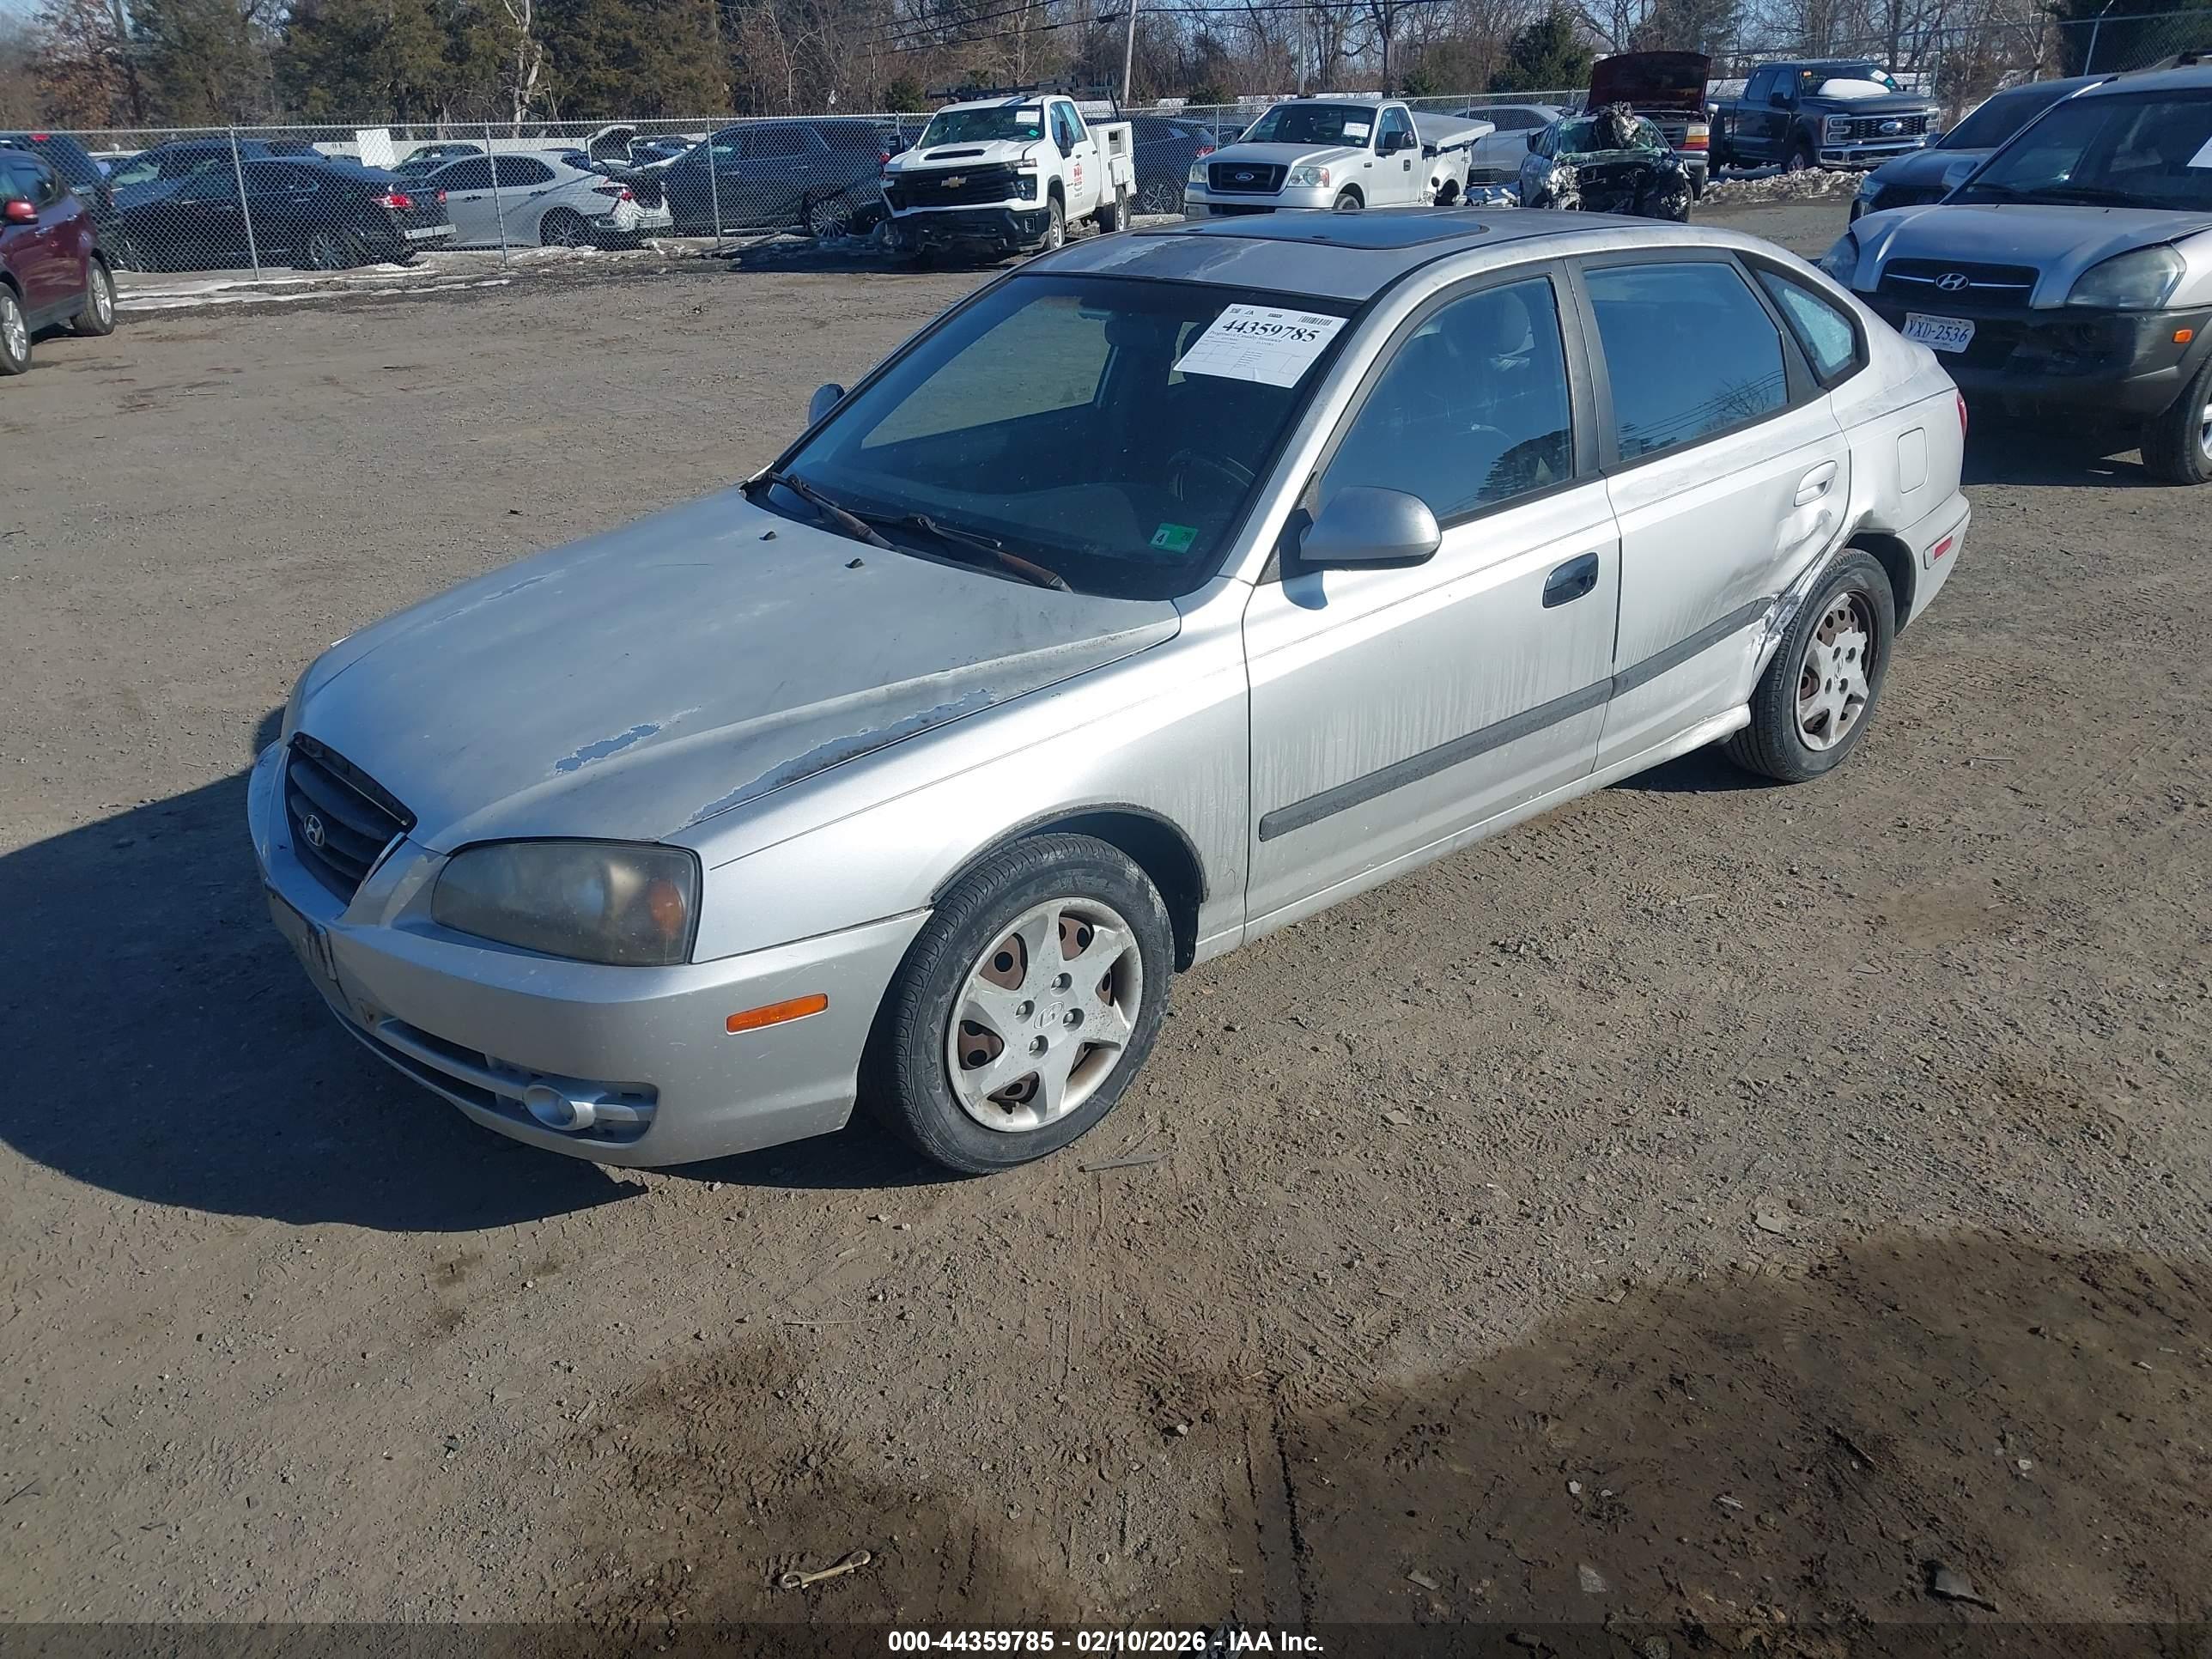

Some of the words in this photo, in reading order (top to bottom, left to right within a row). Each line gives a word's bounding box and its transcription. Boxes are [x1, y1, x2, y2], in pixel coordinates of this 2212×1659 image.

[1223, 319, 1321, 343] 44359785
[1906, 319, 1970, 343] VXD-2536
[1156, 533, 1165, 543] 4
